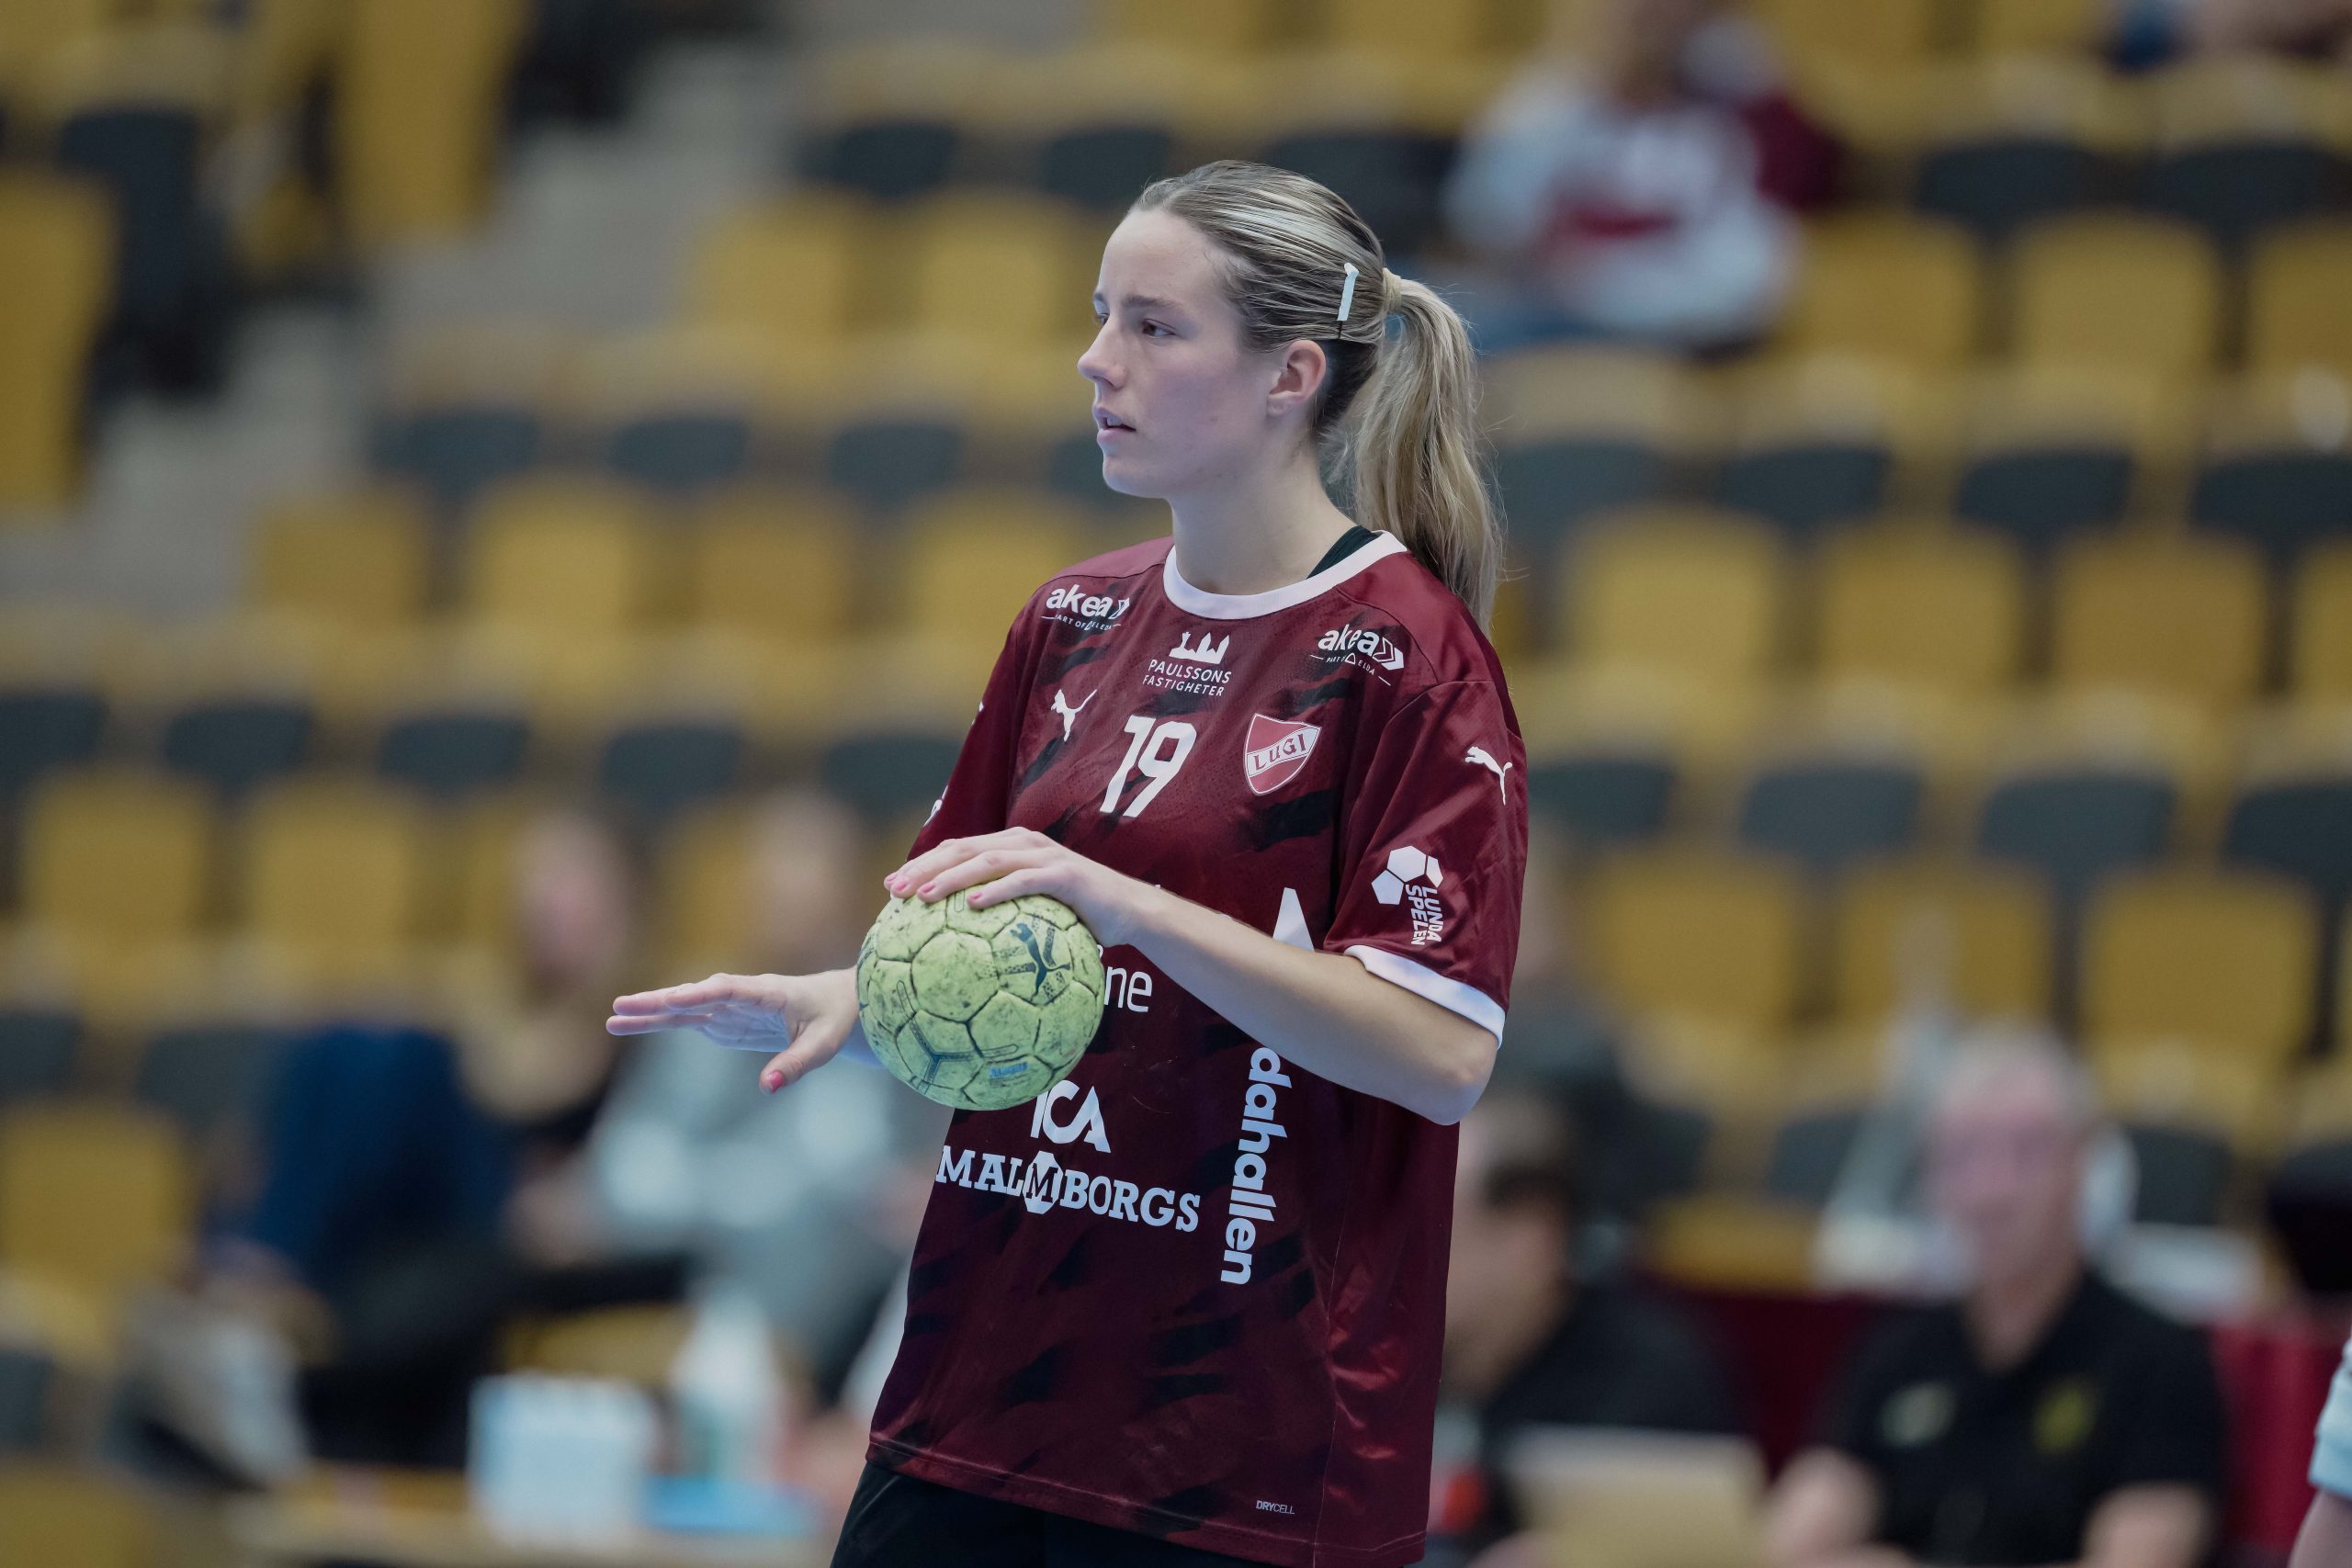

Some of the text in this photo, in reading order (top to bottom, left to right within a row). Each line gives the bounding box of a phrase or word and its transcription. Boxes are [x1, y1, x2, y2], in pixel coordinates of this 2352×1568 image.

[1046, 584, 1114, 617] akea
[1317, 624, 1380, 657] akea
[1142, 674, 1225, 697] FASTIGHETER
[1148, 659, 1232, 684] PAULSSONS
[1099, 715, 1197, 818] 19
[1253, 733, 1306, 772] LUGI
[1405, 884, 1429, 946] SPELEN
[1421, 886, 1444, 942] LUNDA
[1103, 965, 1153, 1013] ne
[1030, 1079, 1112, 1154] ICA
[934, 1145, 1201, 1233] MALMBORGS
[1220, 1046, 1293, 1286] dahallen
[1255, 1499, 1295, 1515] DRYCELL
